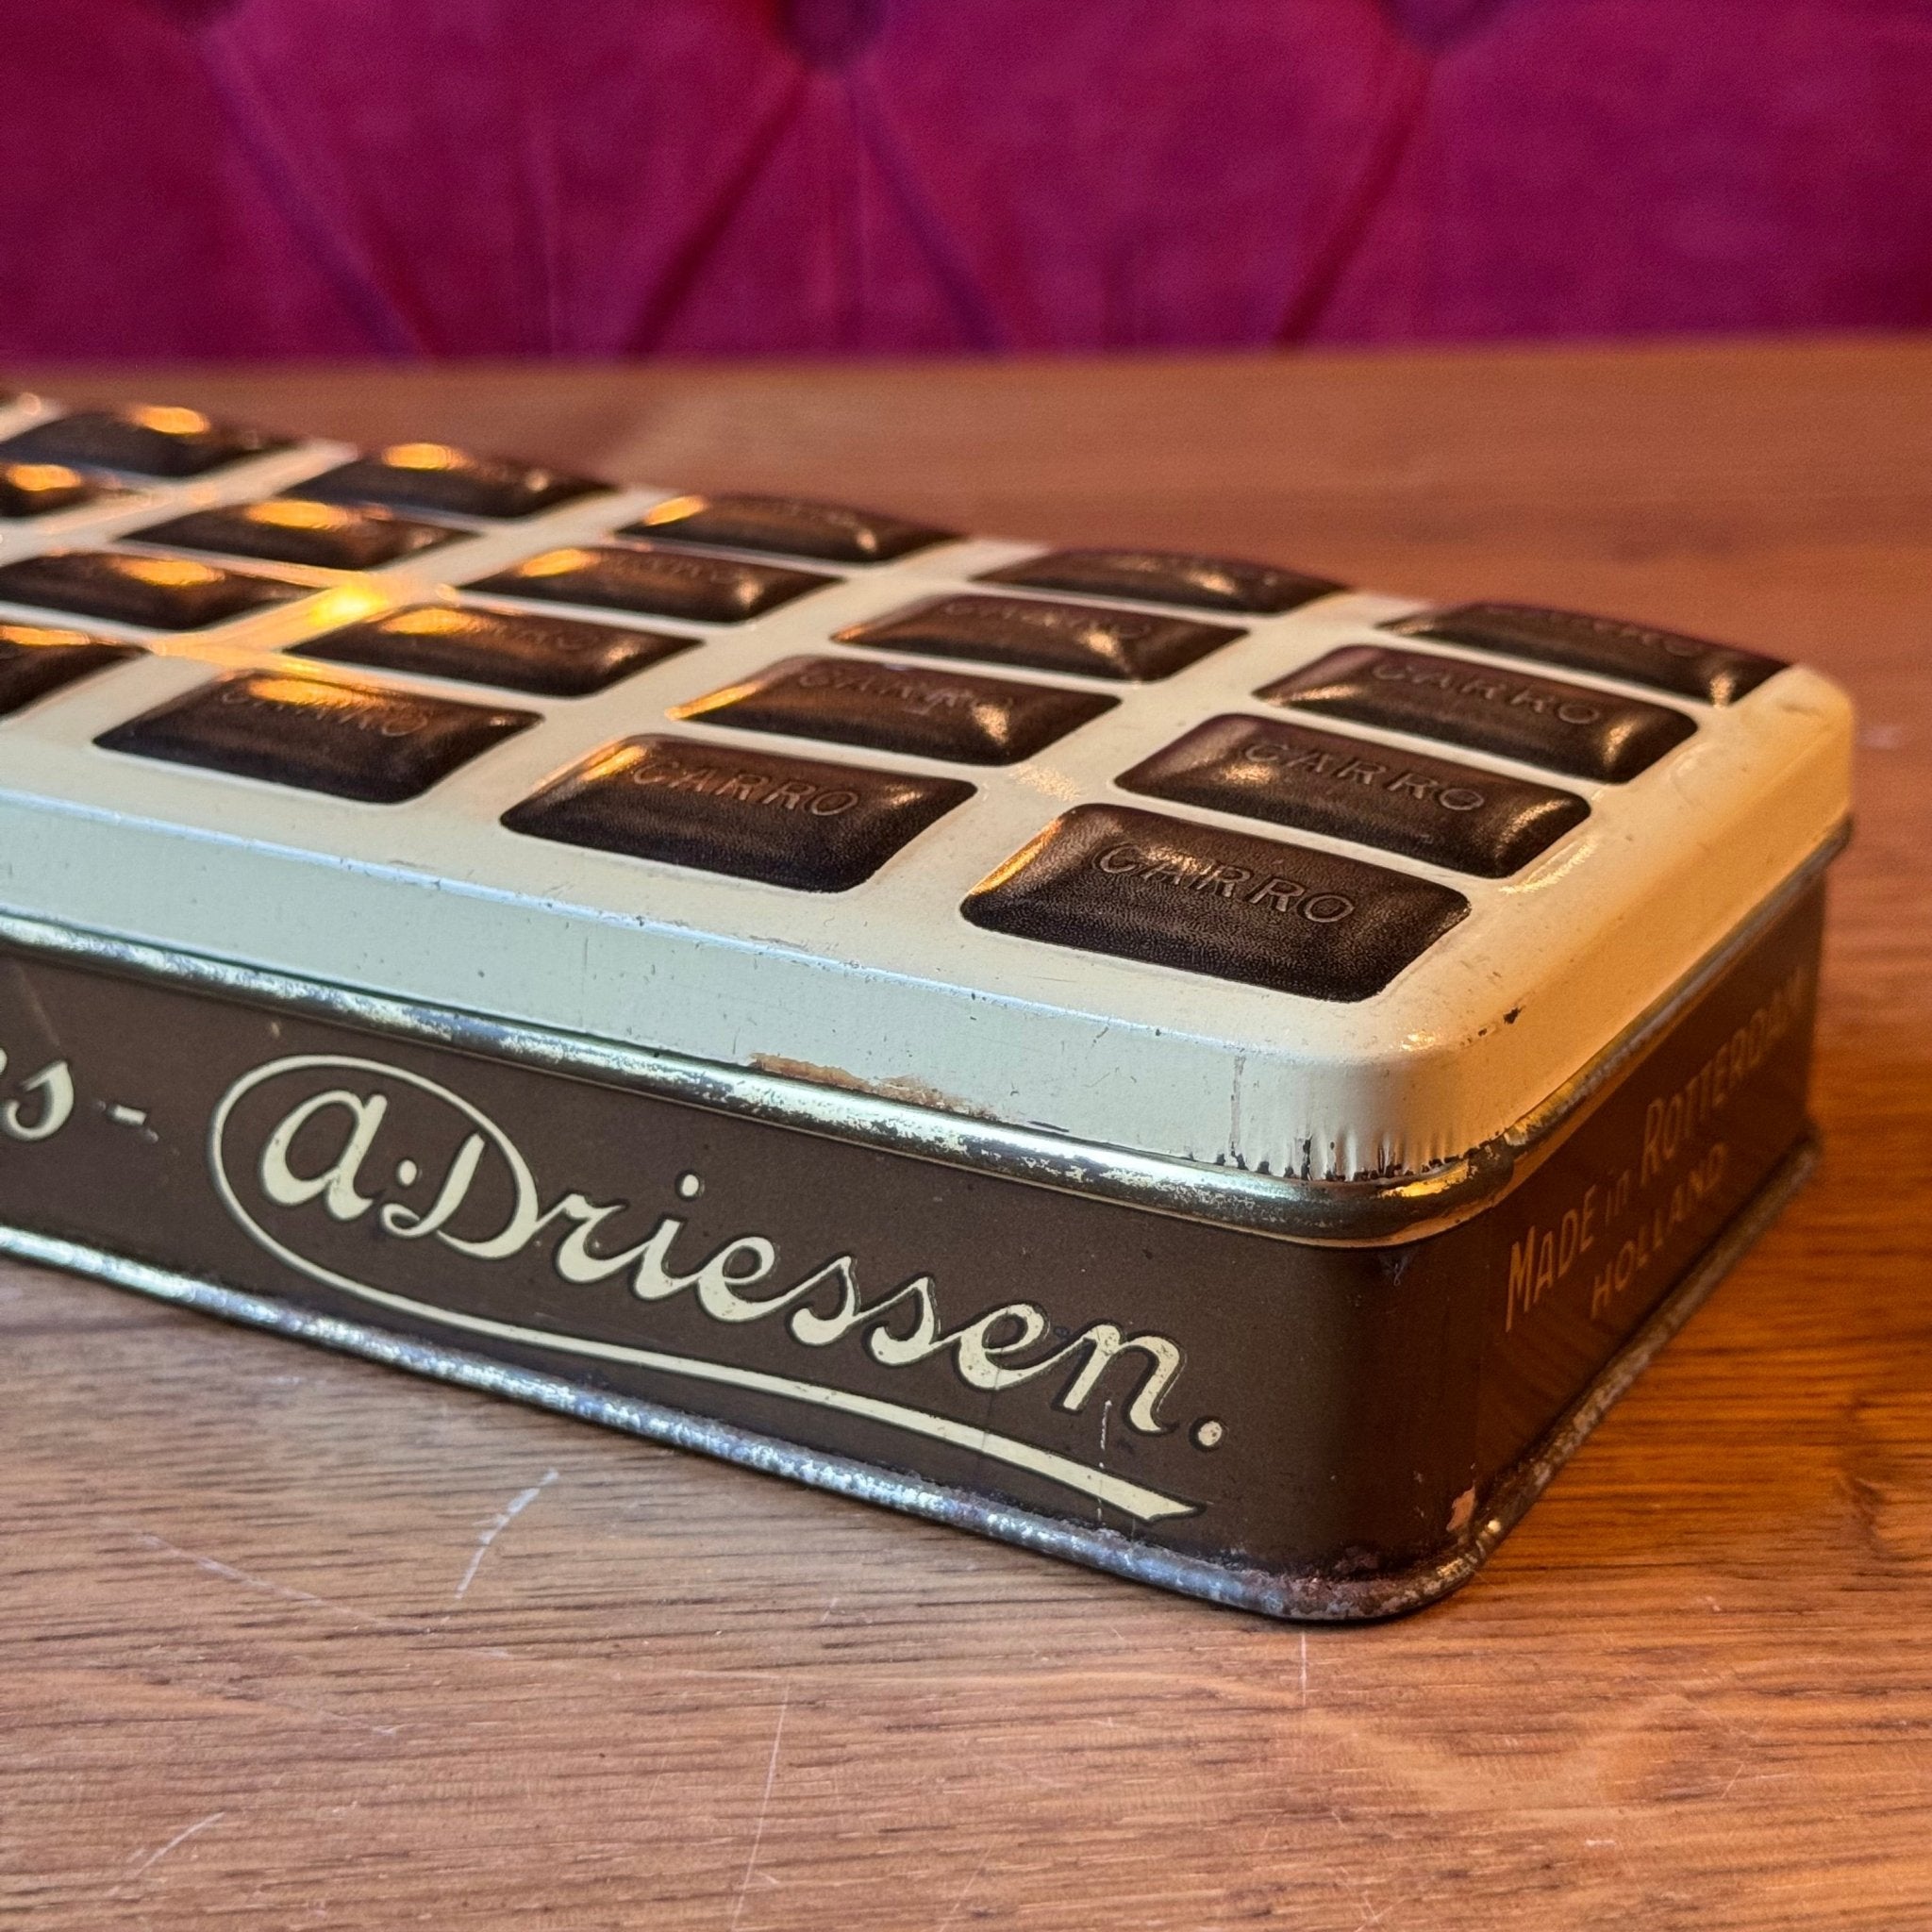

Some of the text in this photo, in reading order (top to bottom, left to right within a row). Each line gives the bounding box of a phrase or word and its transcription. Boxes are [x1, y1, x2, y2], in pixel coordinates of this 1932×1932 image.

[632, 762, 859, 817] CARRO
[1244, 742, 1486, 811] CARRO
[1093, 843, 1356, 924] CARRO
[1504, 1182, 1597, 1334] MADE
